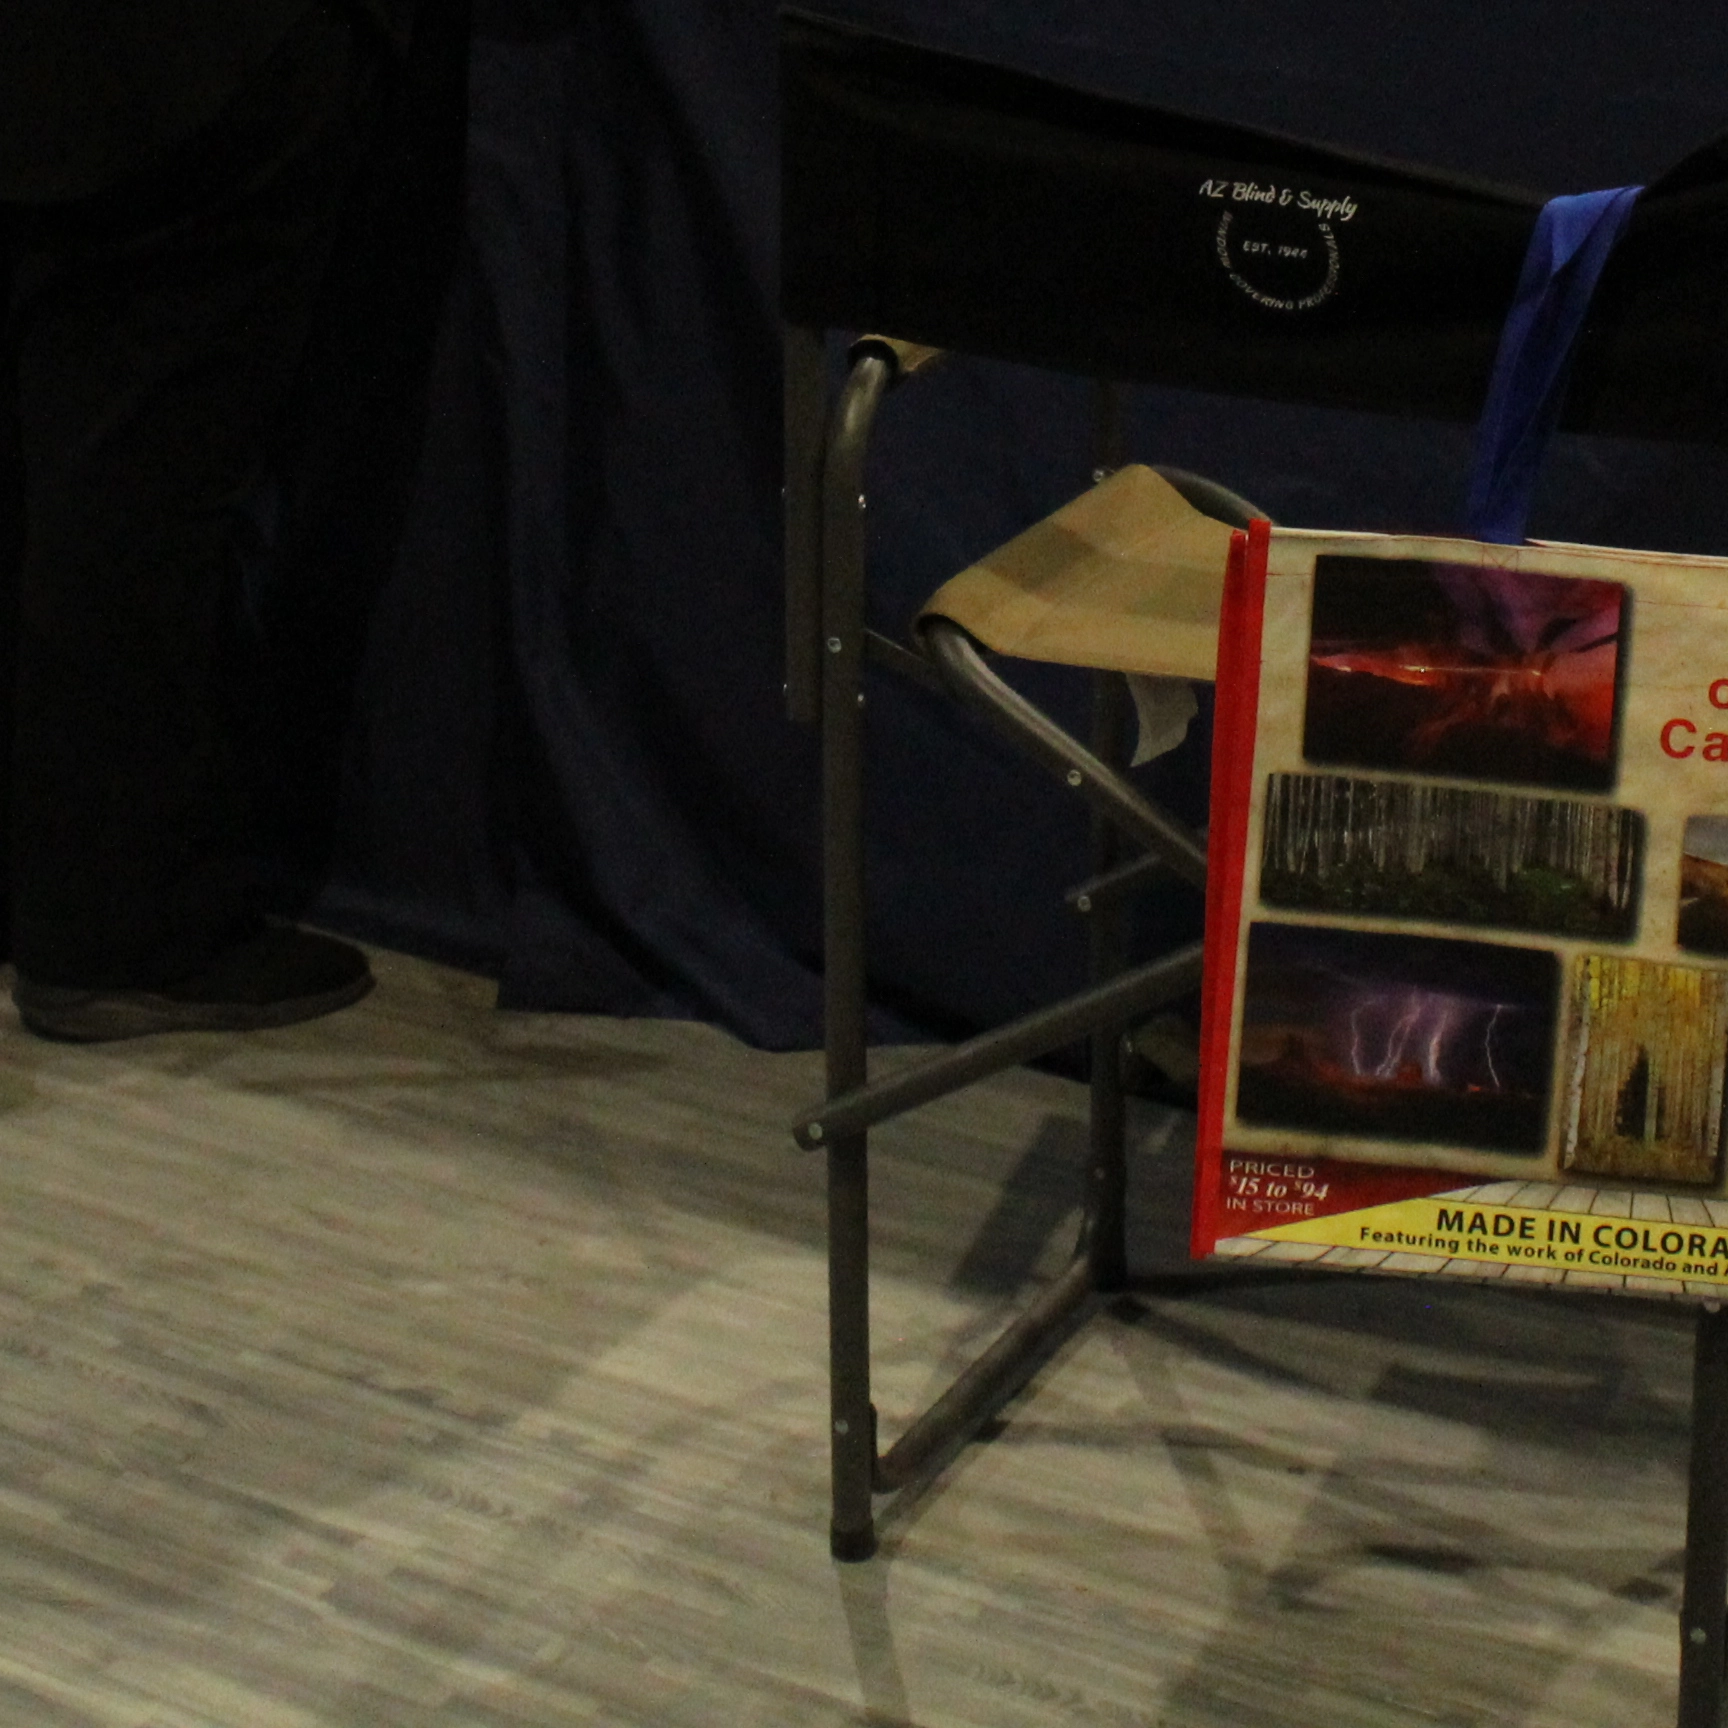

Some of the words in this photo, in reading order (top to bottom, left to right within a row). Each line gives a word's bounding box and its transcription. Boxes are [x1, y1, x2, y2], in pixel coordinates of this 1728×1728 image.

[1198, 178, 1229, 198] AZ
[1230, 181, 1276, 205] Blind
[1278, 188, 1294, 206] &
[1296, 190, 1359, 222] Supply
[1229, 1159, 1315, 1180] PRICED
[1229, 1175, 1261, 1196] $15
[1266, 1180, 1288, 1198] to
[1294, 1179, 1330, 1202] $94
[1226, 1196, 1247, 1211] IN
[1252, 1198, 1315, 1216] STORE
[1436, 1208, 1537, 1241] MADE
[1547, 1218, 1581, 1245] IN
[1360, 1226, 1460, 1254] Featuring
[1466, 1238, 1500, 1255] the
[1507, 1244, 1557, 1261] work
[1564, 1248, 1584, 1264] of
[1589, 1249, 1677, 1271] Colorado
[1682, 1257, 1718, 1276] and
